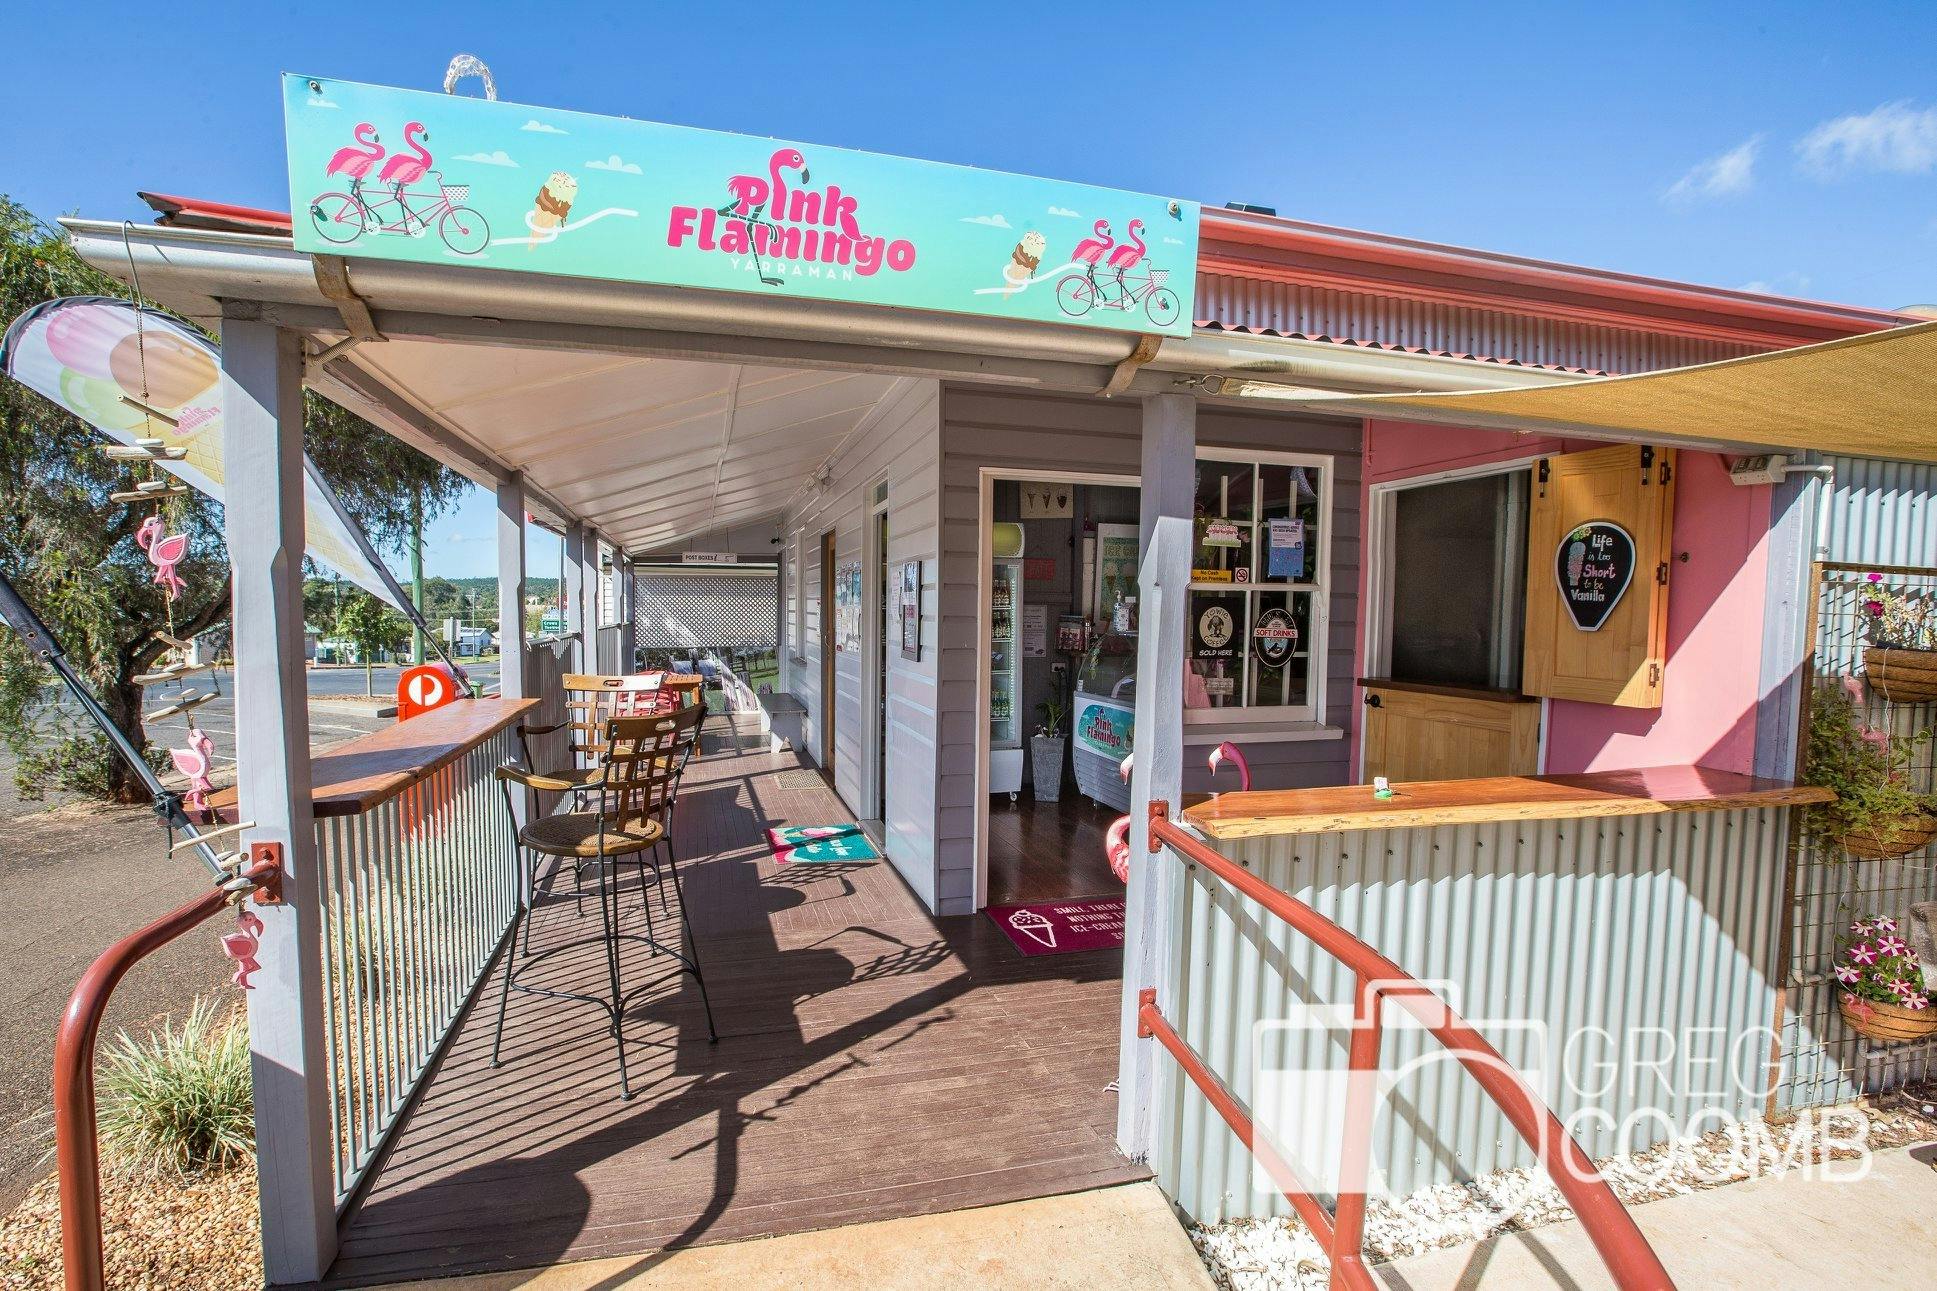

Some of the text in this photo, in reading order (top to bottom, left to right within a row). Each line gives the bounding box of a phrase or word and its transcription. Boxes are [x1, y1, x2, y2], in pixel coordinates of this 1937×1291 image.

[728, 153, 866, 240] Pink
[667, 206, 916, 276] Flamingo
[730, 257, 853, 281] YARRAMAN
[1592, 534, 1613, 552] Life
[1588, 551, 1611, 562] is too
[1583, 563, 1616, 579] Short
[1584, 578, 1604, 589] to be
[1570, 589, 1605, 602] Vanilla
[1256, 629, 1296, 637] SOFT DRINKS
[1086, 726, 1121, 747] Flamingo
[1066, 912, 1113, 923] NOTHING
